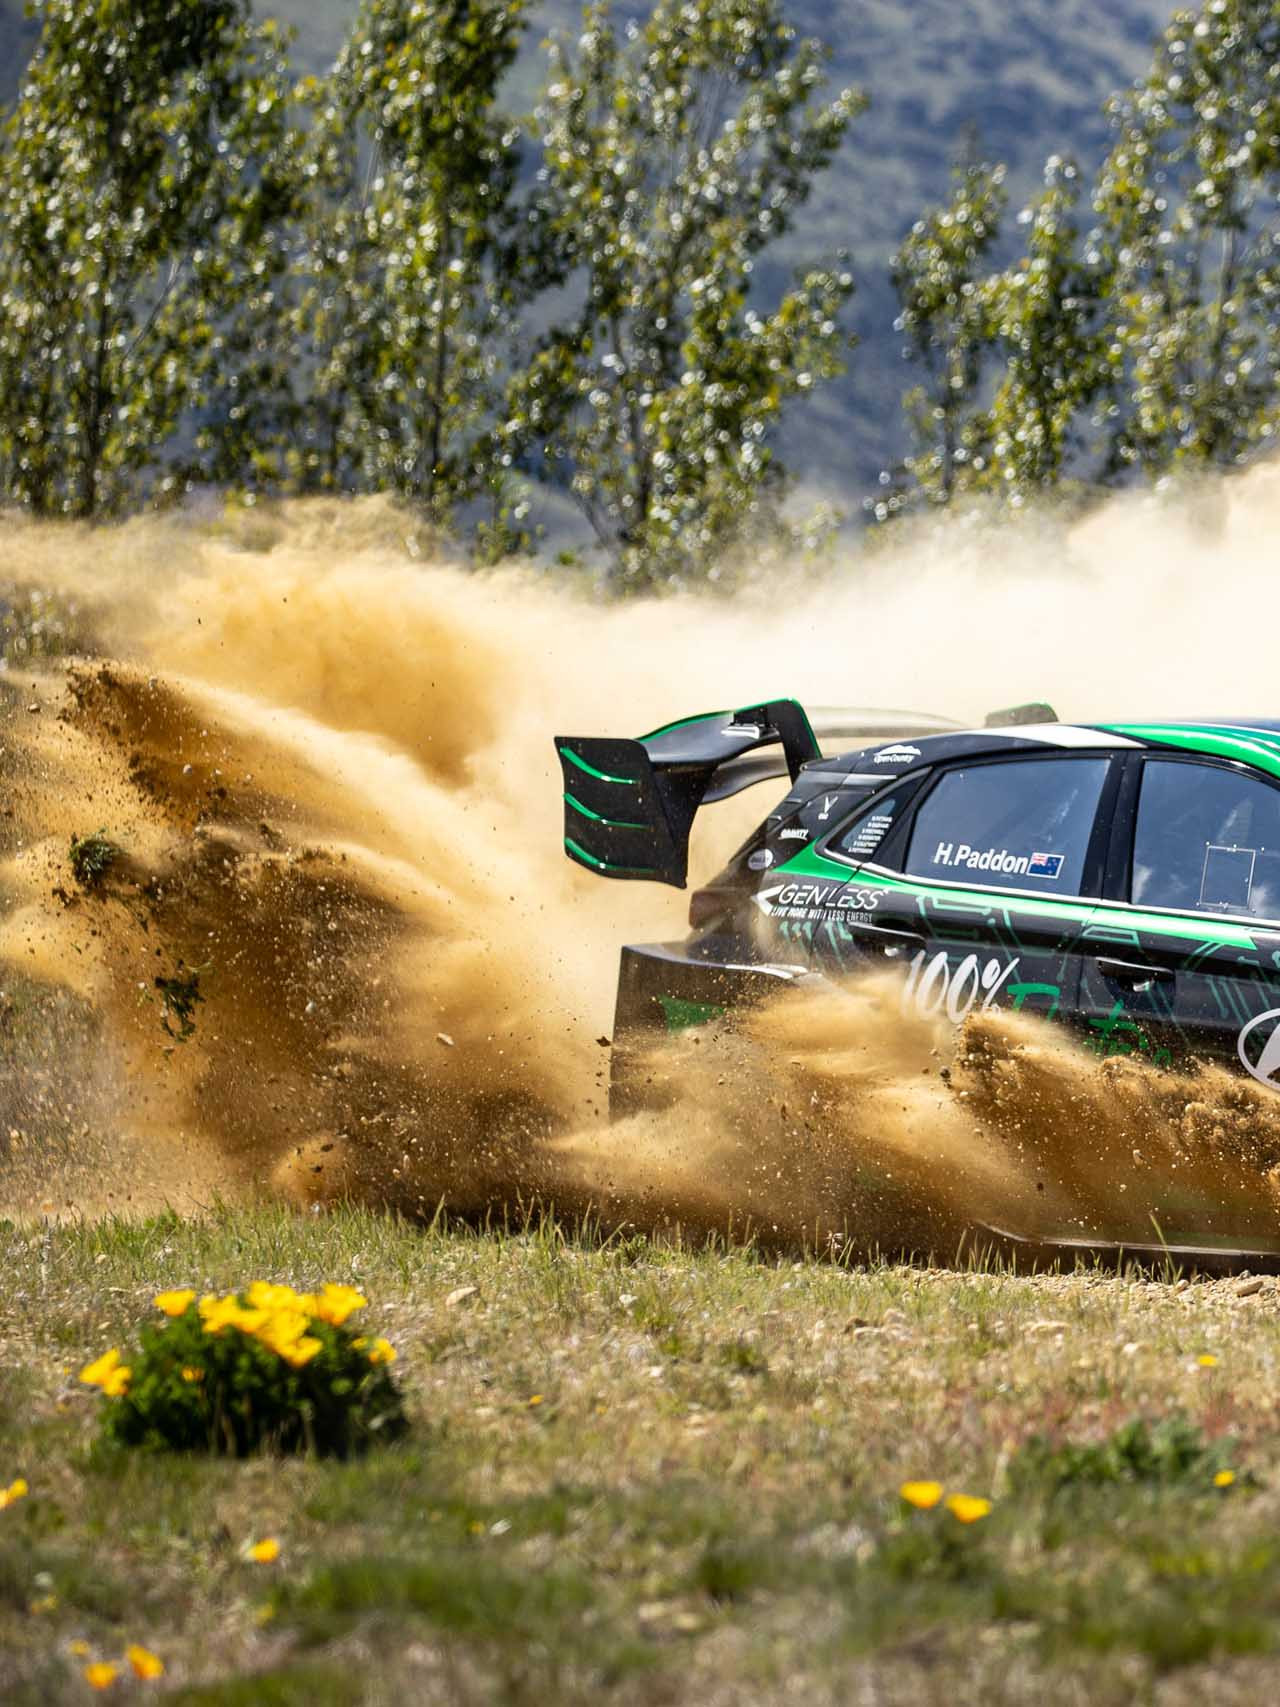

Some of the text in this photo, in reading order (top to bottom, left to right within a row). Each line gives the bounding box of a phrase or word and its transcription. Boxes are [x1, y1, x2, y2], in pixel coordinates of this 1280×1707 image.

[933, 842, 1028, 874] H.Paddon
[787, 907, 808, 919] MORE
[846, 912, 873, 923] ENERGY
